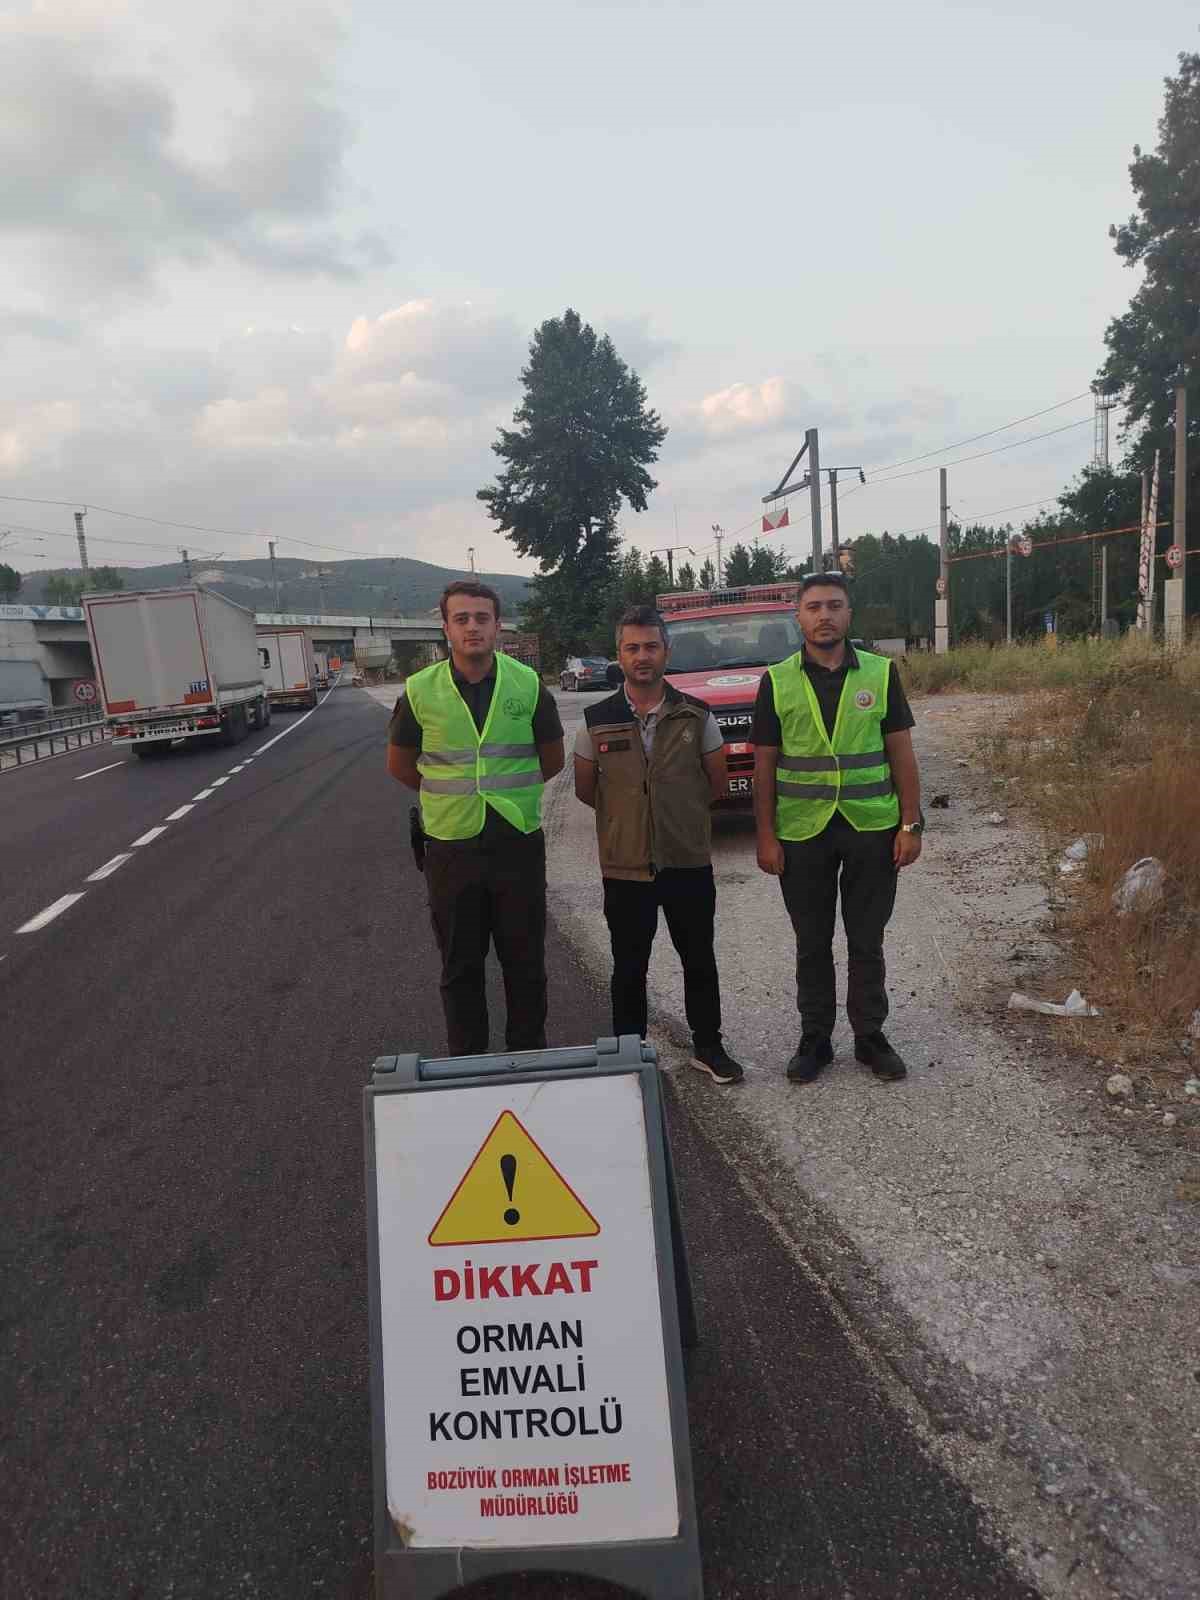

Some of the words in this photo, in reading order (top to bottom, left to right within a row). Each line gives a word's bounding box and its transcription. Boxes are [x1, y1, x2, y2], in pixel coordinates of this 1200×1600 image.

[718, 715, 752, 727] SUZ
[433, 1260, 600, 1302] DİKKAT
[456, 1319, 584, 1355] ORMAN
[460, 1354, 586, 1398] EMVALİ
[429, 1397, 623, 1442] KONTROLÜ
[427, 1466, 498, 1491] BOZÜYÜK
[501, 1466, 561, 1488] ORMAN
[563, 1462, 632, 1488] İŞLETME
[479, 1492, 579, 1518] MÜDÜRLÜĞÜ
